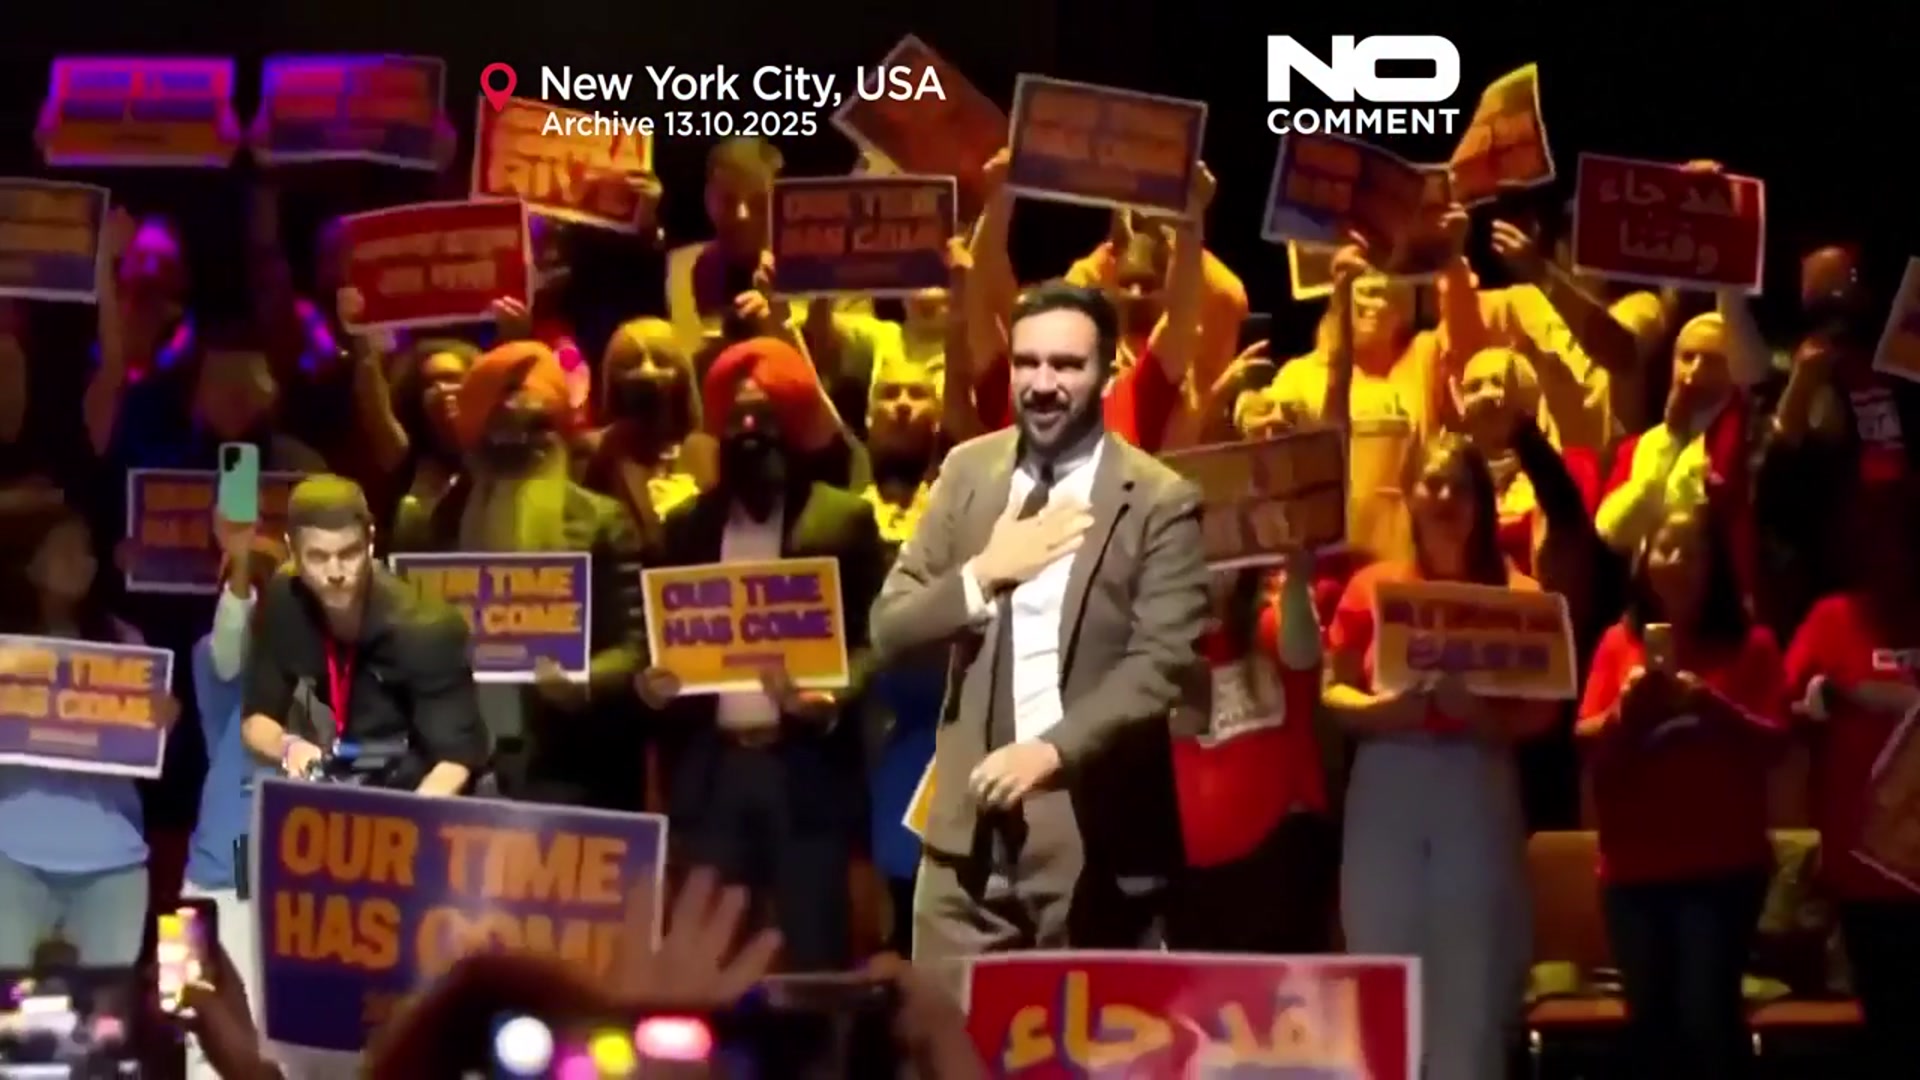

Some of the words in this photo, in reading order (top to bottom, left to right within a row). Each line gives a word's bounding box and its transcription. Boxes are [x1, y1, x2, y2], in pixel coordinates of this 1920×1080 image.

[489, 565, 573, 598] TIME
[662, 578, 732, 612] OUR
[740, 573, 823, 606] TIME
[482, 602, 583, 635] COME
[663, 614, 734, 647] HAS
[739, 607, 835, 644] COME
[71, 654, 154, 689] TIME
[56, 688, 157, 729] COME
[279, 805, 420, 887] OUR
[440, 824, 628, 904] TIME
[273, 890, 401, 971] HAS
